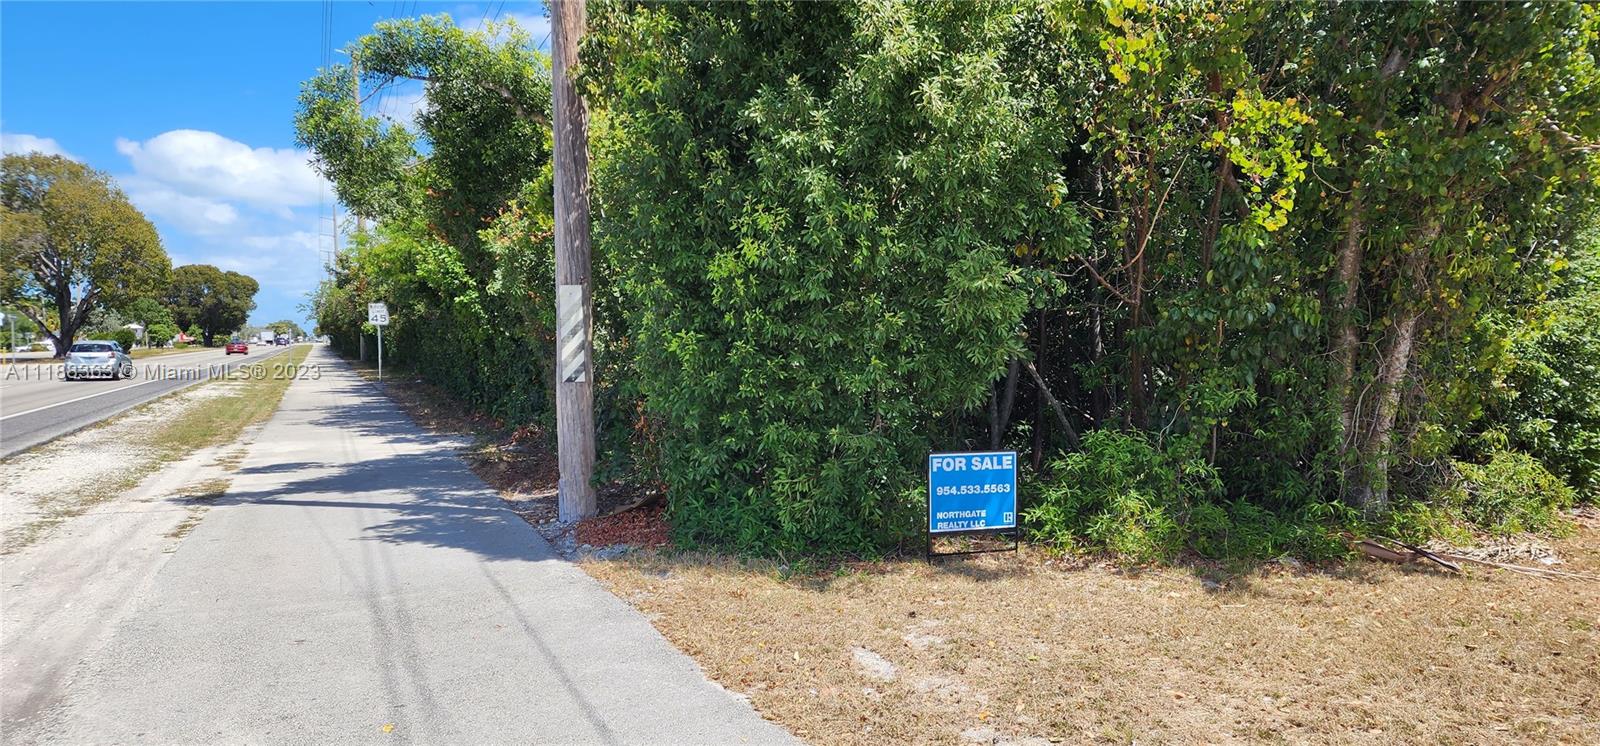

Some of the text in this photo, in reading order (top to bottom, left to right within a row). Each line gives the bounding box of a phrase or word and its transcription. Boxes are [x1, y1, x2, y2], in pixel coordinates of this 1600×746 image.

[932, 455, 1013, 472] FOR SALE
[936, 484, 1011, 496] 954.533.5563
[936, 509, 987, 519] NORTHGATE
[937, 519, 986, 530] REALTY LLC
